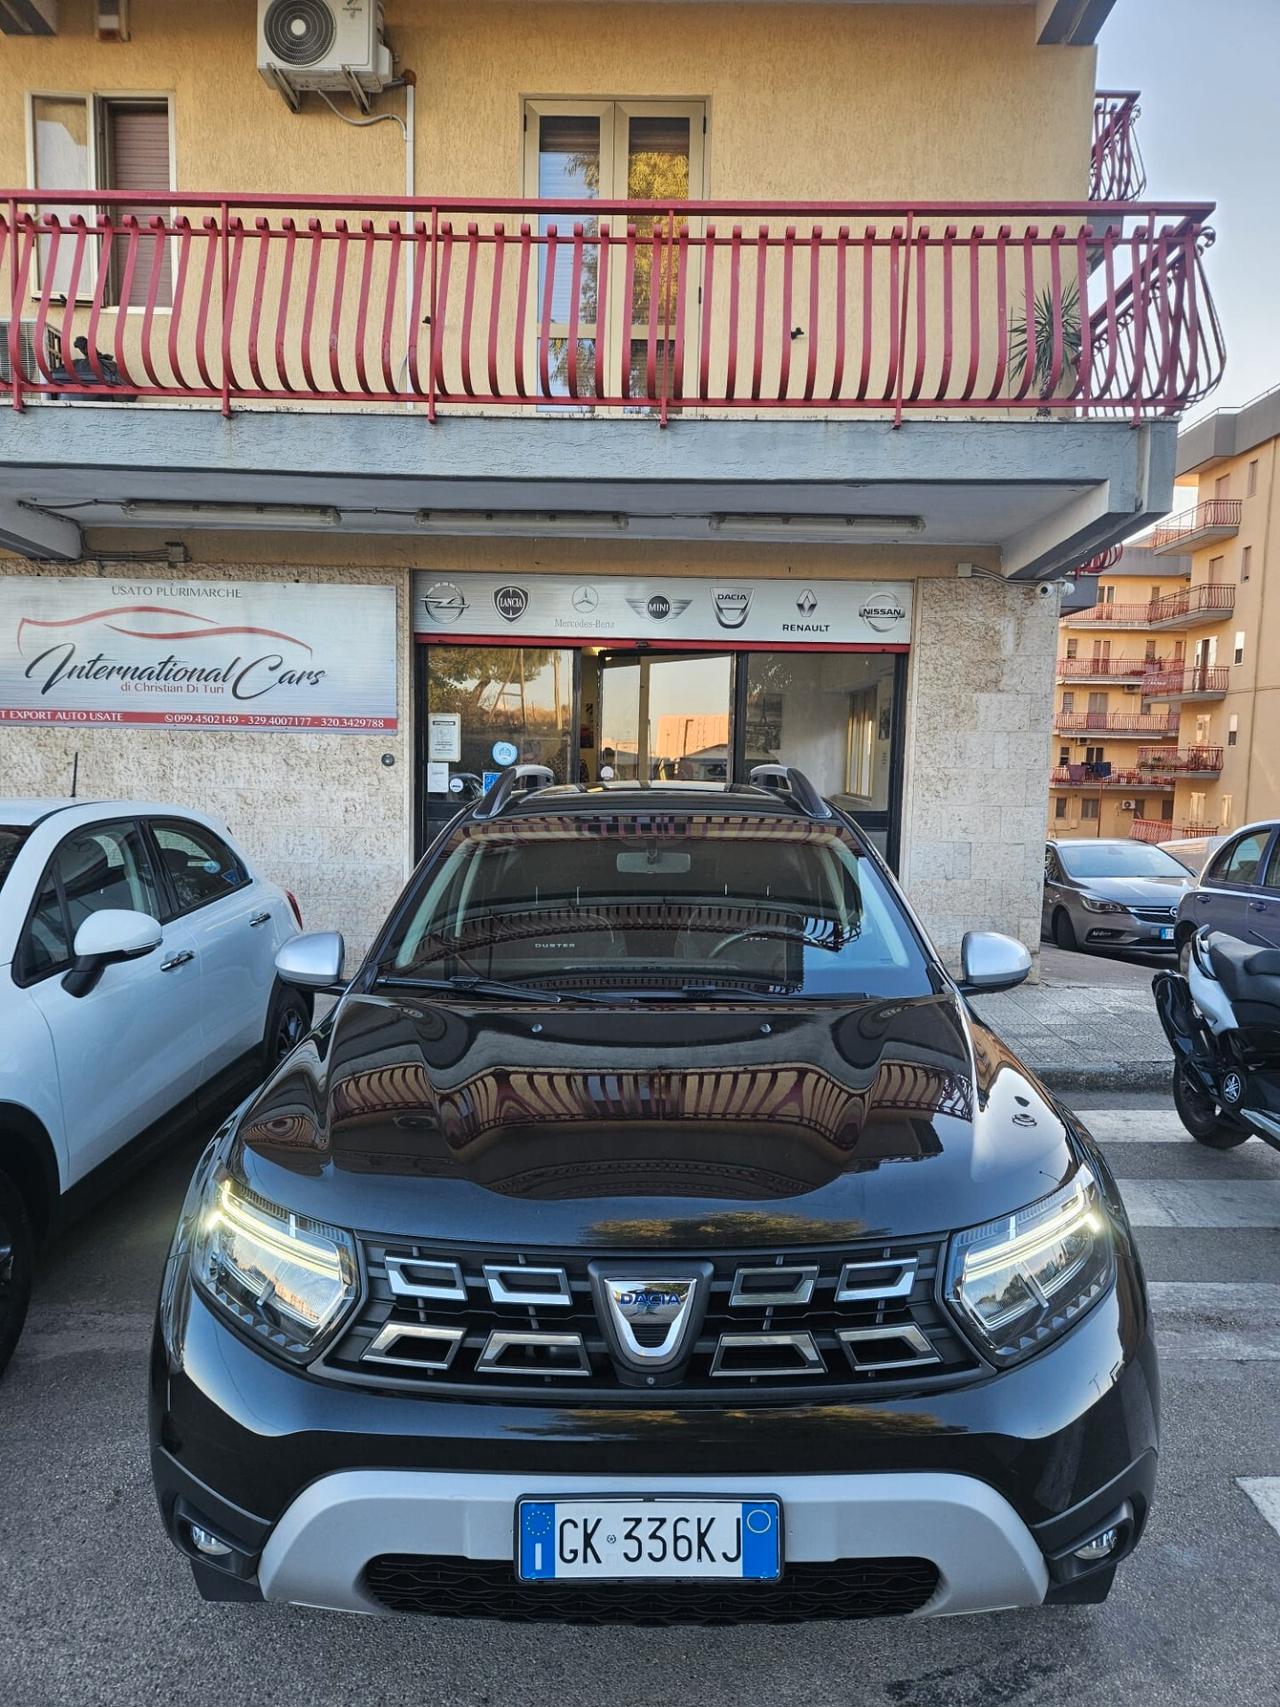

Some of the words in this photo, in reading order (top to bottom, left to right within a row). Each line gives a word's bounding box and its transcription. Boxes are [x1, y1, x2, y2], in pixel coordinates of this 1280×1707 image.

[111, 585, 153, 597] USATO
[156, 586, 243, 599] PLURIMARCHE
[717, 593, 748, 602] DACIA
[500, 596, 523, 609] LANCIA
[648, 602, 670, 613] MINI
[862, 607, 902, 617] NISSAN
[554, 618, 615, 630] Mercedes-Benz
[782, 623, 831, 633] RENAULT
[25, 642, 241, 696] International
[231, 654, 328, 700] Cars
[120, 682, 131, 693] di
[134, 682, 183, 694] Christian
[186, 683, 199, 694] Di
[202, 683, 225, 695] Turi
[9, 711, 52, 721] EXPORT
[55, 711, 87, 722] AUTO
[90, 713, 125, 722] USATE
[173, 714, 240, 725] 099.4502149
[247, 715, 312, 727] 329.4007177
[320, 717, 385, 728] 320.3429788
[619, 1292, 682, 1306] DACIA
[558, 1517, 603, 1564] GK
[622, 1516, 742, 1563] 336KJ
